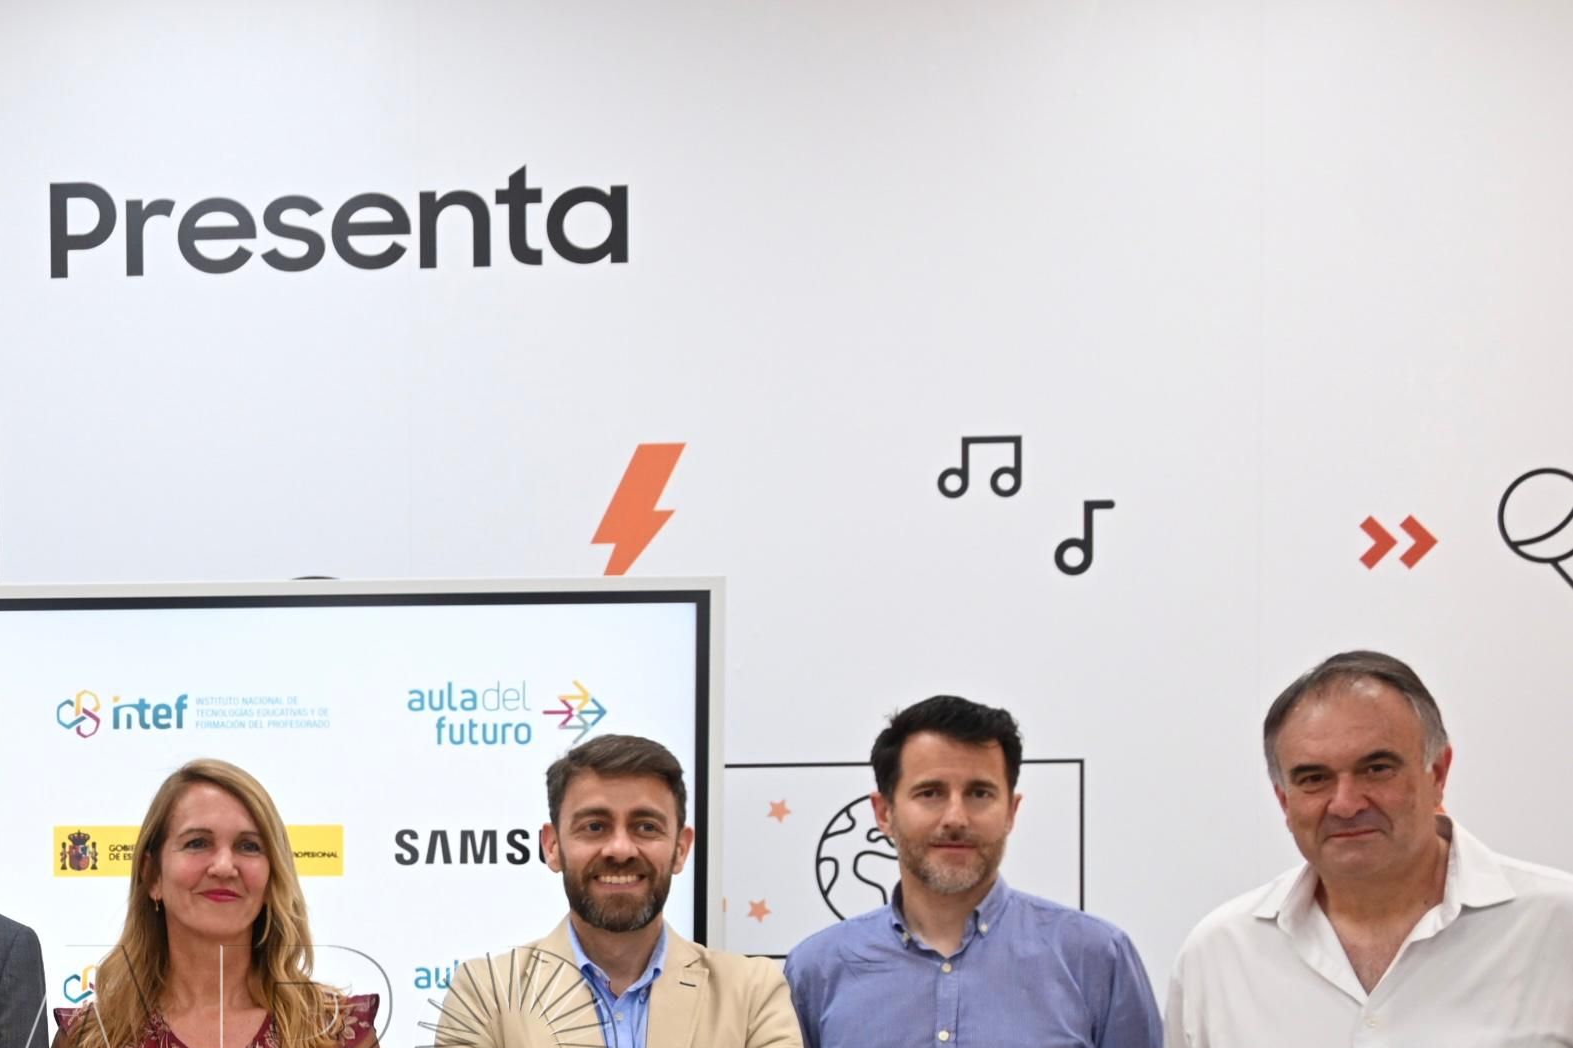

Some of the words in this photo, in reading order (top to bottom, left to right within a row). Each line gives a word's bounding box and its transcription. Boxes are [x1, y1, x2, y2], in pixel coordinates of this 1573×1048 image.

[49, 163, 629, 279] Presenta
[112, 694, 188, 730] intef
[241, 696, 284, 705] NACIONAL
[286, 695, 298, 705] DE
[435, 716, 532, 746] futuro
[394, 829, 547, 866] SAMS
